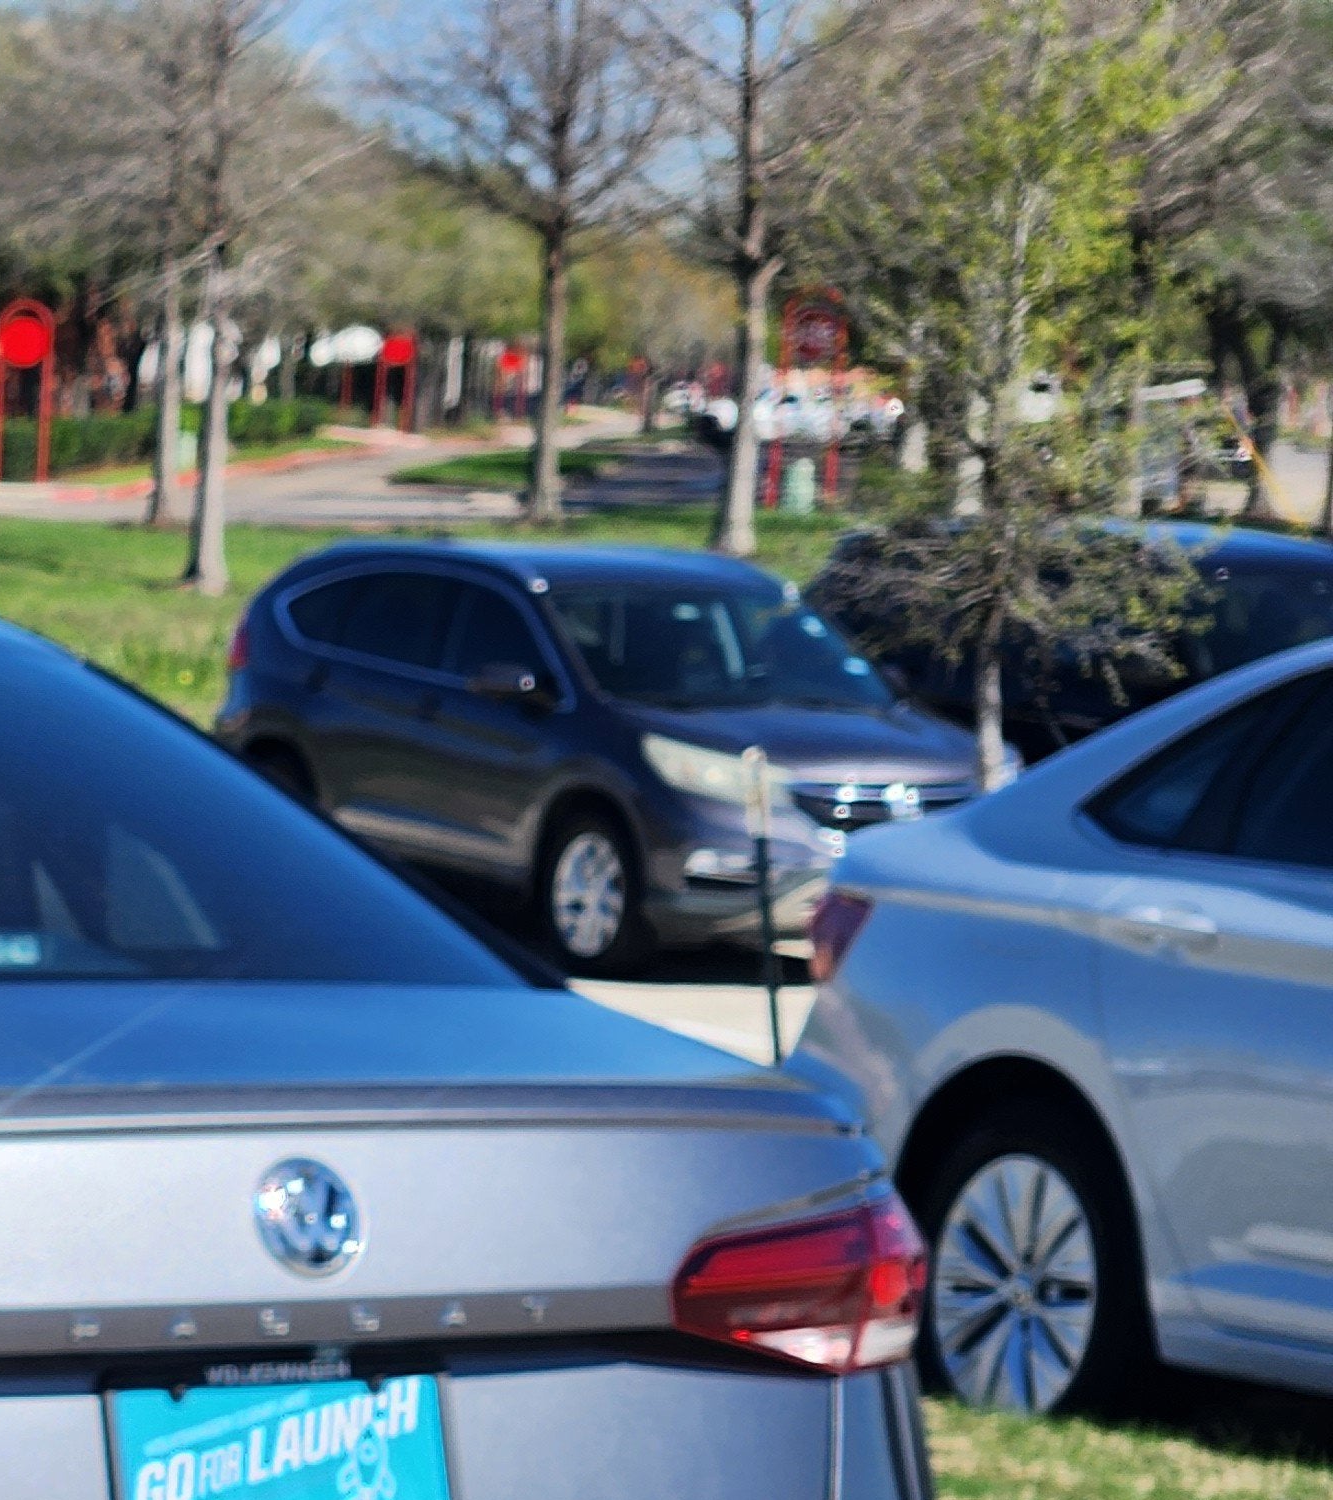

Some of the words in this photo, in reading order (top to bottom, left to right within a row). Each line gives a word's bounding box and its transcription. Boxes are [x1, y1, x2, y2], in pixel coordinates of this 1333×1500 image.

[72, 1295, 551, 1341] PASSAT
[198, 1441, 243, 1497] FOR
[247, 1377, 420, 1485] LAUNCH
